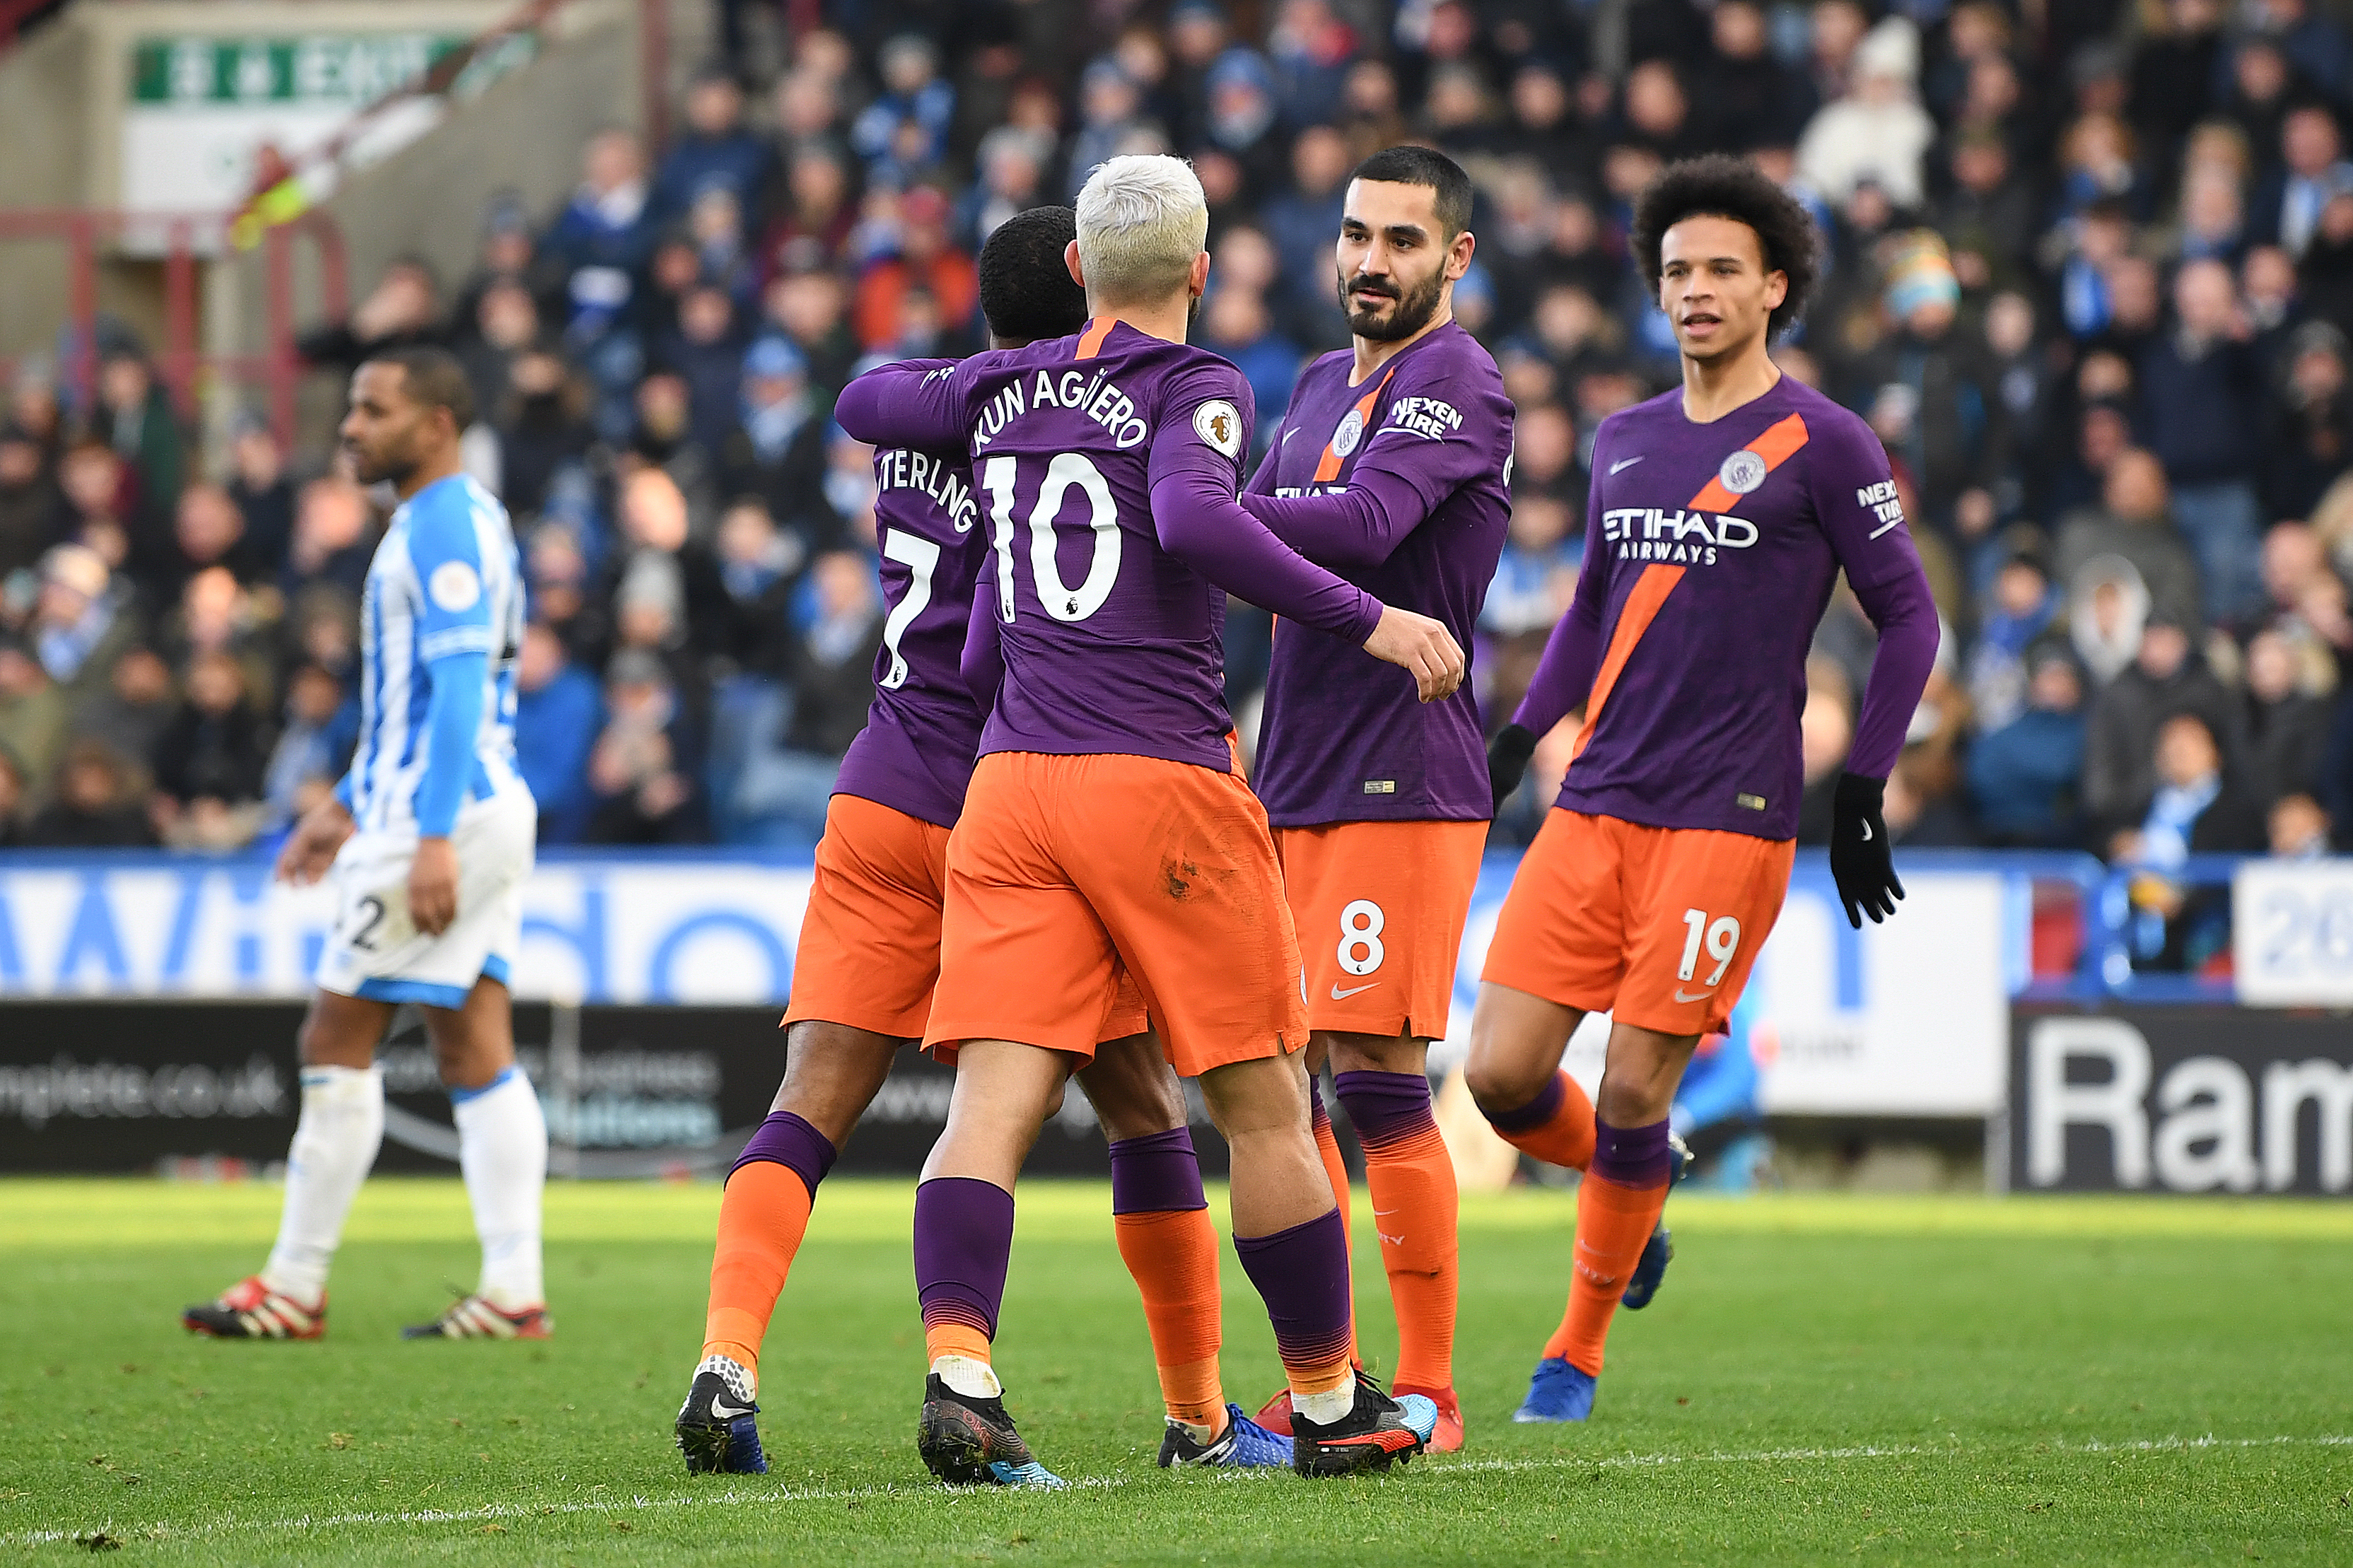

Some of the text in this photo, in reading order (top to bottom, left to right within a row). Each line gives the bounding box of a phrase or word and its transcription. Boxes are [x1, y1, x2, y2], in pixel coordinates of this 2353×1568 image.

[974, 379, 1025, 457] KUN
[1032, 368, 1148, 448] AGÜERO
[1391, 397, 1464, 431] NEXEN
[1394, 410, 1447, 440] TIRE
[1856, 479, 1898, 508] NEX
[1873, 499, 1903, 524] TIR
[981, 452, 1123, 623] 10
[1603, 508, 1761, 550] ETIHAD
[1618, 540, 1718, 566] AIRWAYS
[879, 526, 942, 691] 7
[335, 894, 387, 952] 2
[1337, 899, 1386, 976] 8
[1676, 908, 1741, 987] 19
